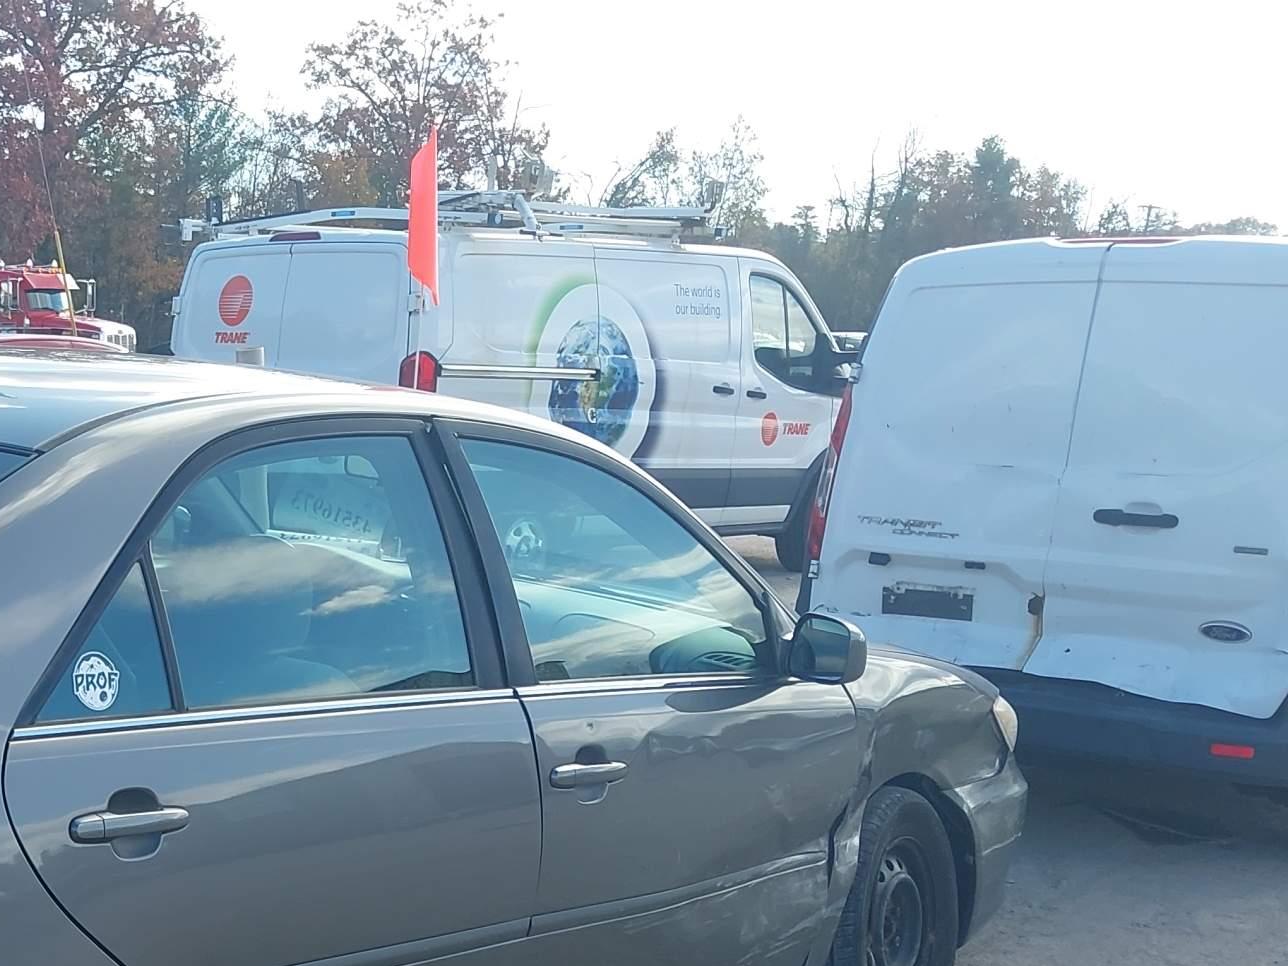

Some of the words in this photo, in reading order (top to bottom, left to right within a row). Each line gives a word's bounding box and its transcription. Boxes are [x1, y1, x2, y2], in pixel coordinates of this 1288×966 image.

[673, 283, 689, 297] The
[691, 286, 713, 298] world
[714, 288, 721, 298] is
[675, 304, 689, 315] our
[215, 331, 251, 344] TRANE
[783, 422, 811, 436] TRANE
[857, 515, 942, 529] TRANSIT
[892, 528, 960, 539] CONNECT
[74, 671, 118, 692] PROF
